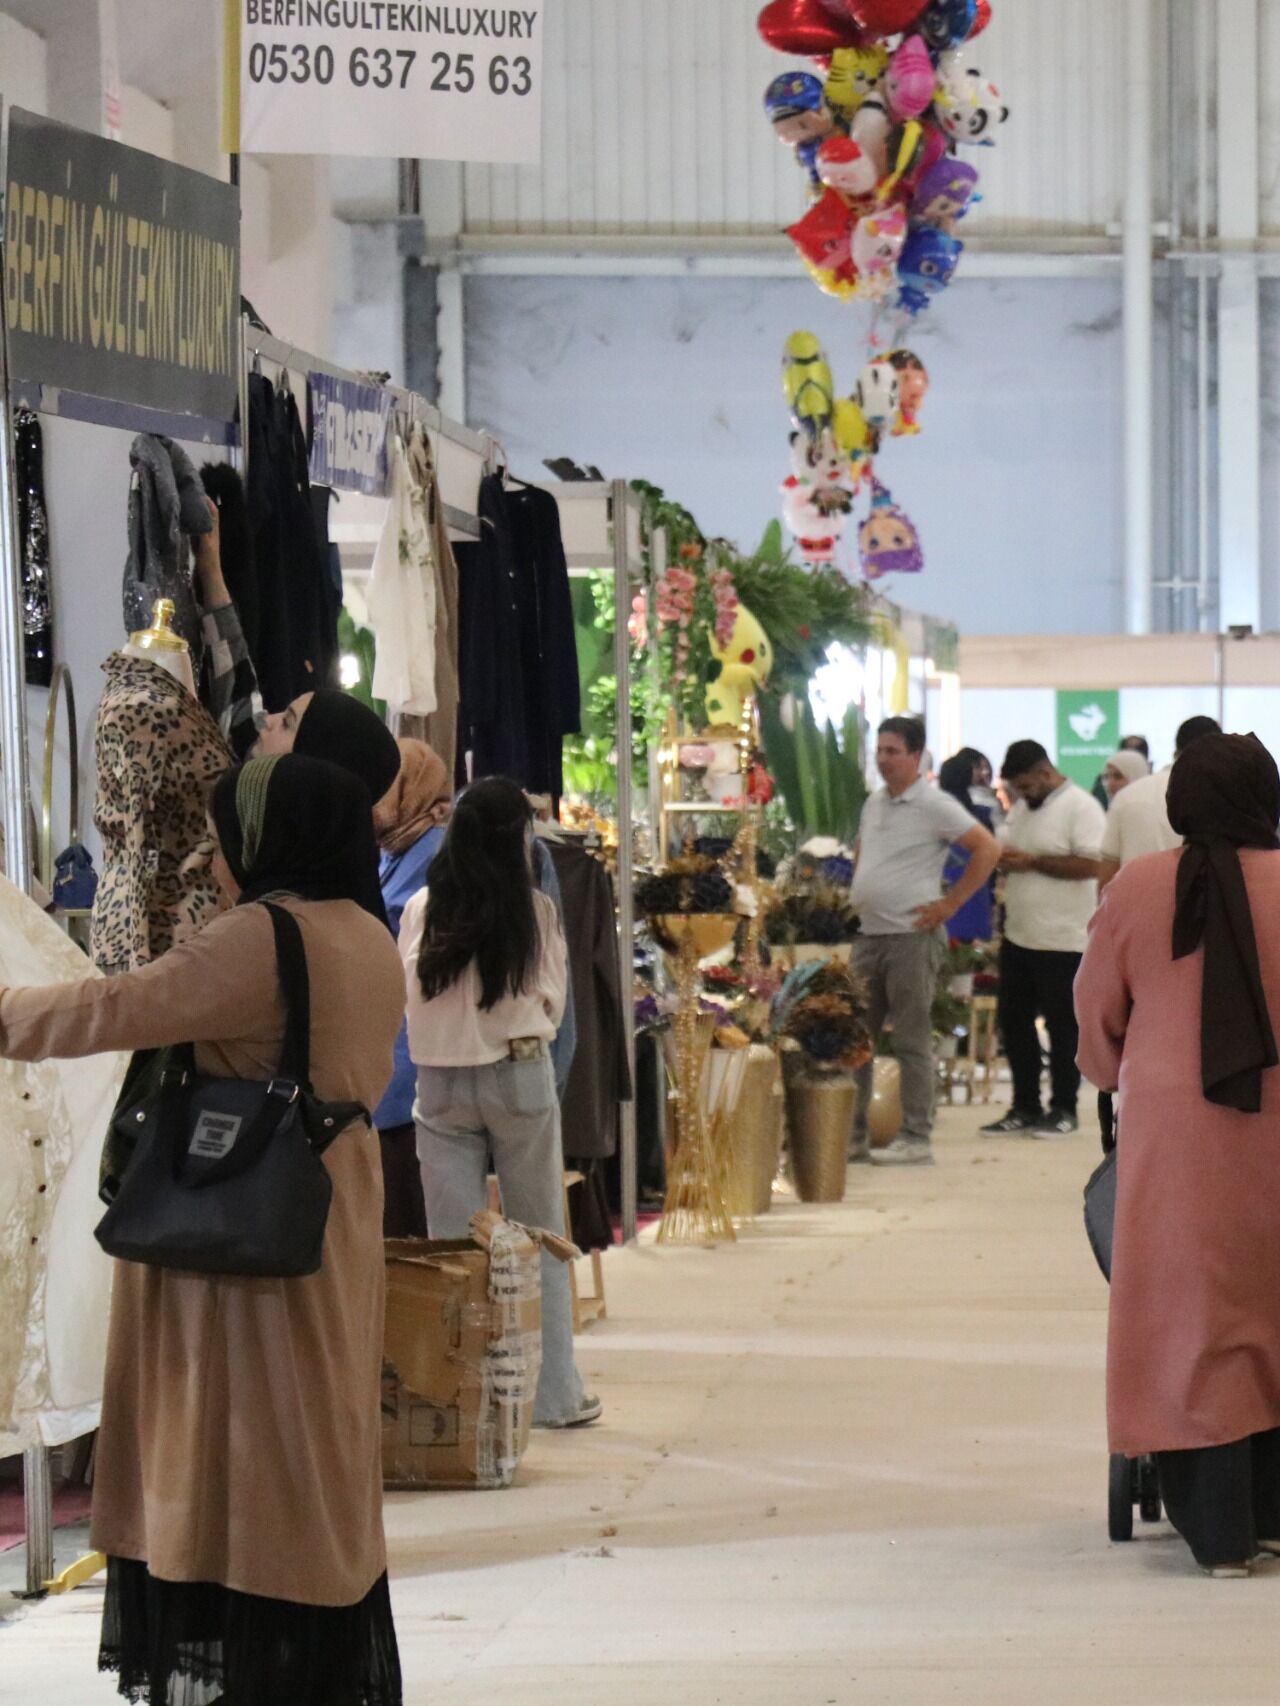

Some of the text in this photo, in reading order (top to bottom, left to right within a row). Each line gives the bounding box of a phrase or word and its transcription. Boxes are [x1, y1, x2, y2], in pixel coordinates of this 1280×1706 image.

[249, 42, 532, 96] 0530 637 25 63
[6, 159, 235, 377] BERFİN GÜLTEKİN LUXURY
